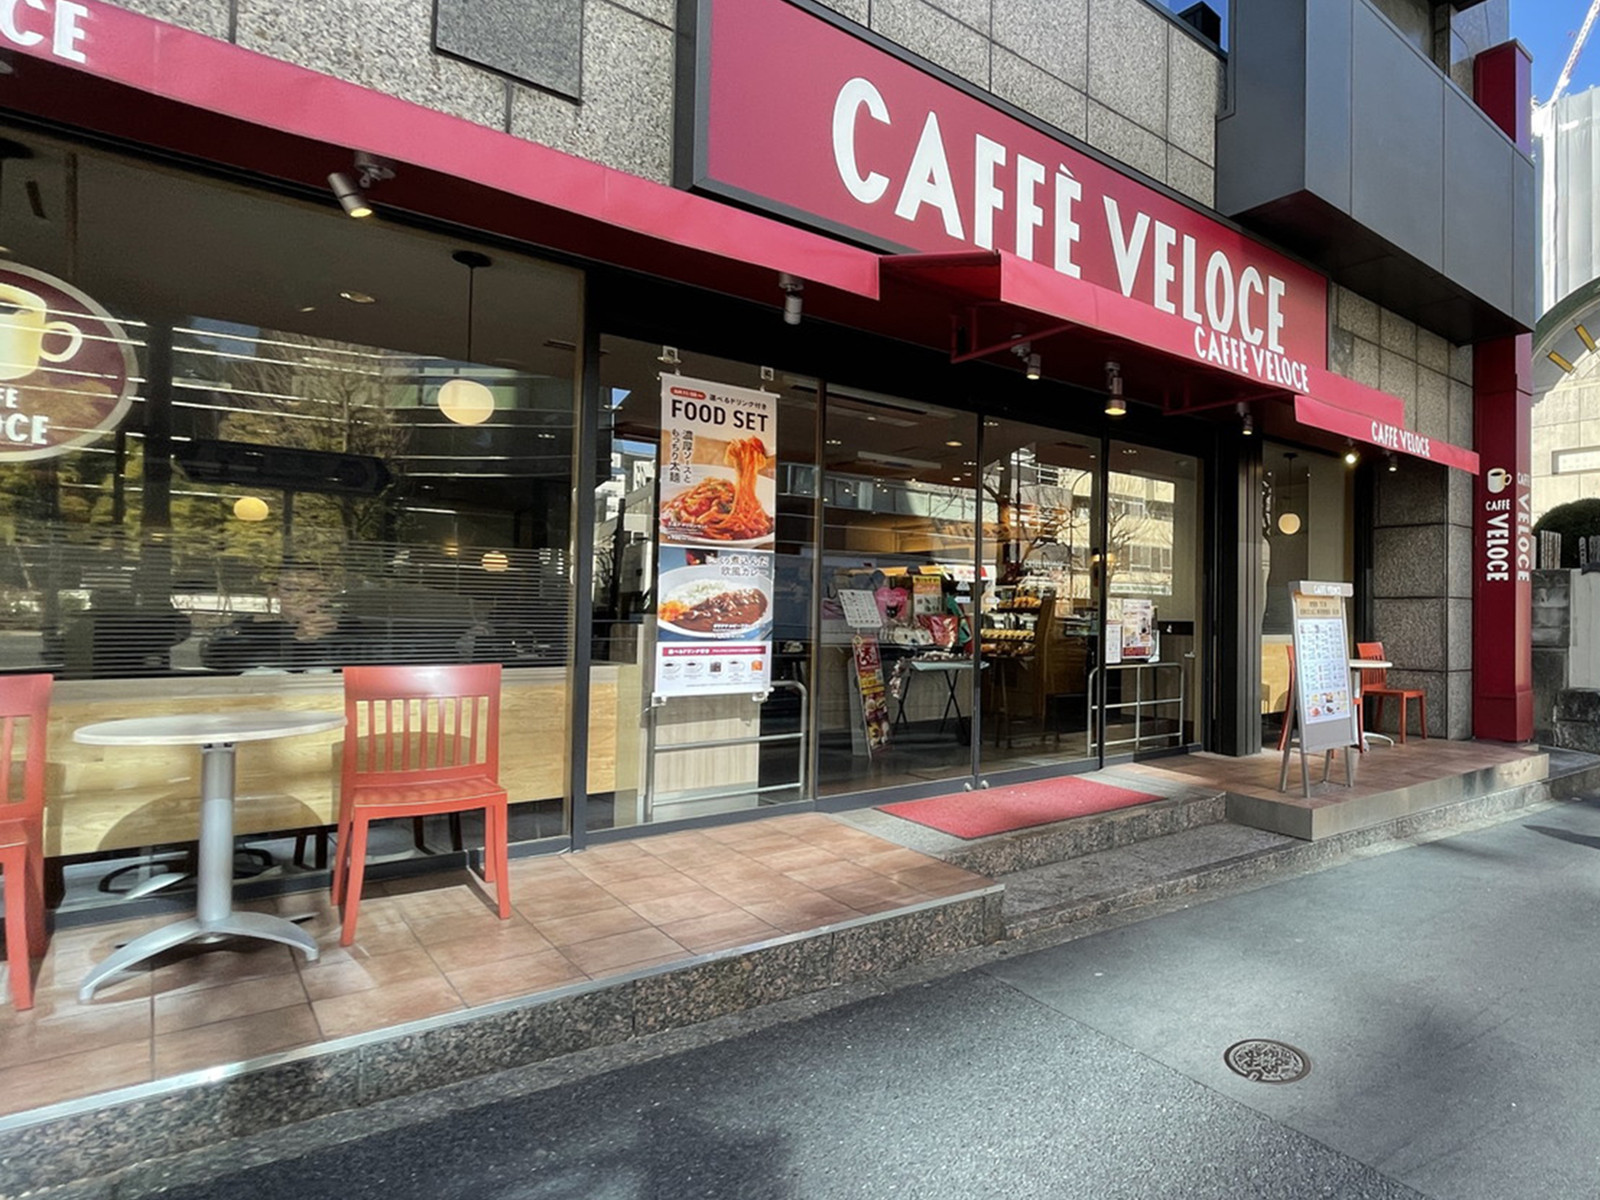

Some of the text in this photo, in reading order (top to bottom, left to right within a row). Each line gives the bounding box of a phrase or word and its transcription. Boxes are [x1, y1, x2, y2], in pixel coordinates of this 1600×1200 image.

[832, 77, 1286, 355] CAFFÈ VELOCE
[1251, 345, 1310, 393] VELOCE
[0, 413, 49, 444] CE
[672, 399, 769, 432] FOOD SET
[1399, 429, 1431, 457] VELOCE
[1486, 512, 1510, 582] VELOCE
[1517, 493, 1530, 582] VELOCE
